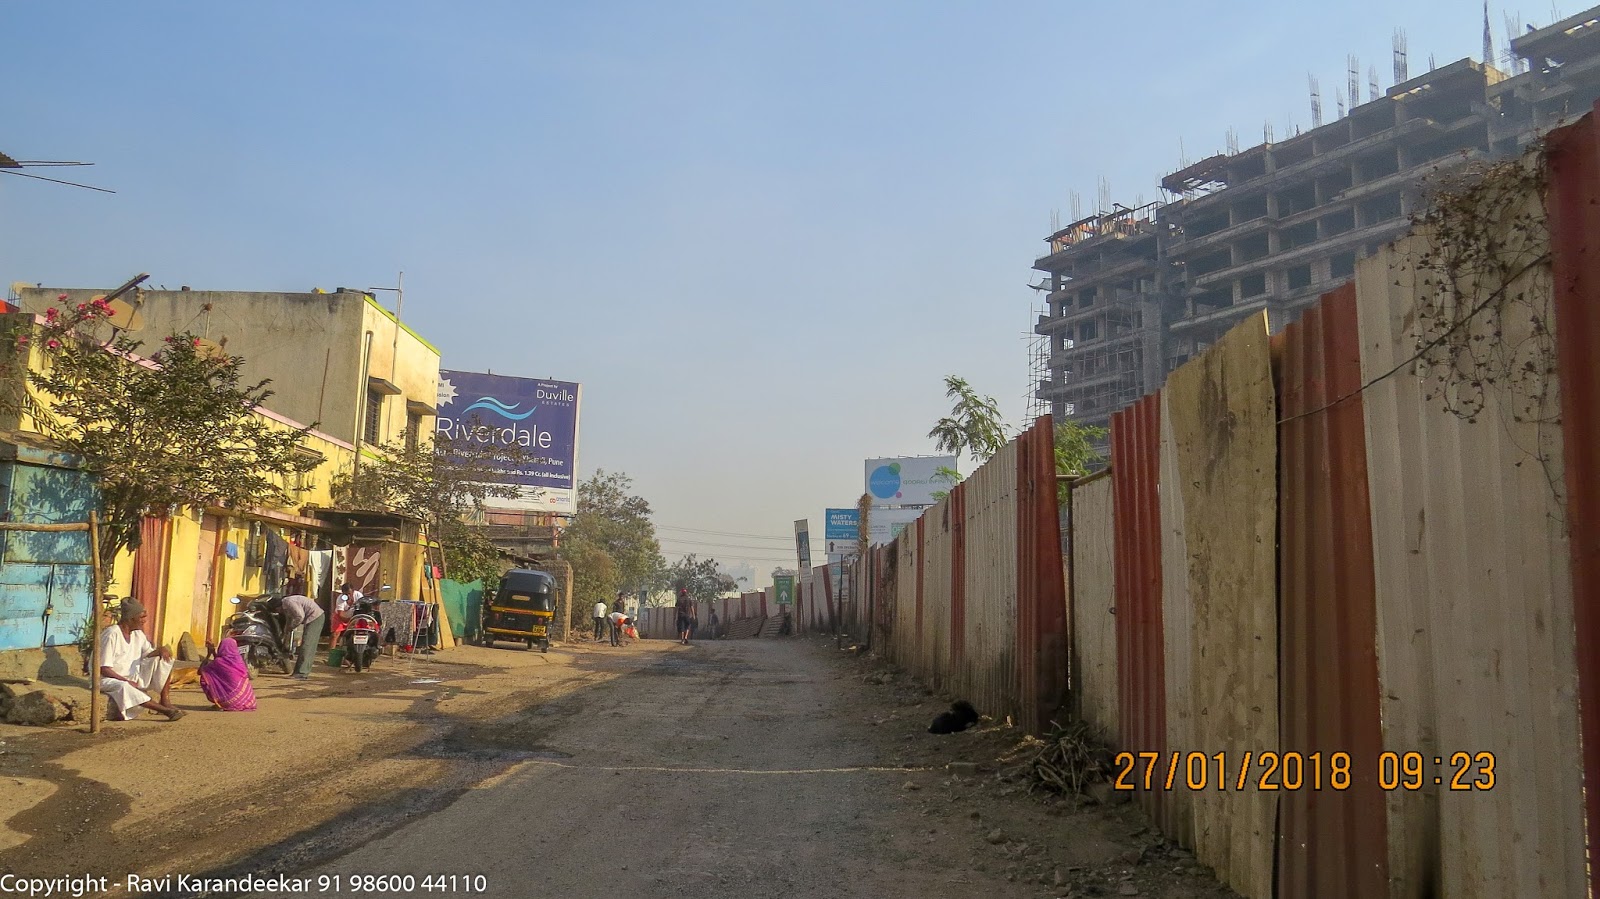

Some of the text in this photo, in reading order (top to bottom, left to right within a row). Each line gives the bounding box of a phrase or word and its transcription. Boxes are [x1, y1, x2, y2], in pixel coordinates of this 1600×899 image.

[536, 389, 574, 402] Duville
[436, 417, 552, 449] Riverdale
[548, 457, 564, 467] Pune
